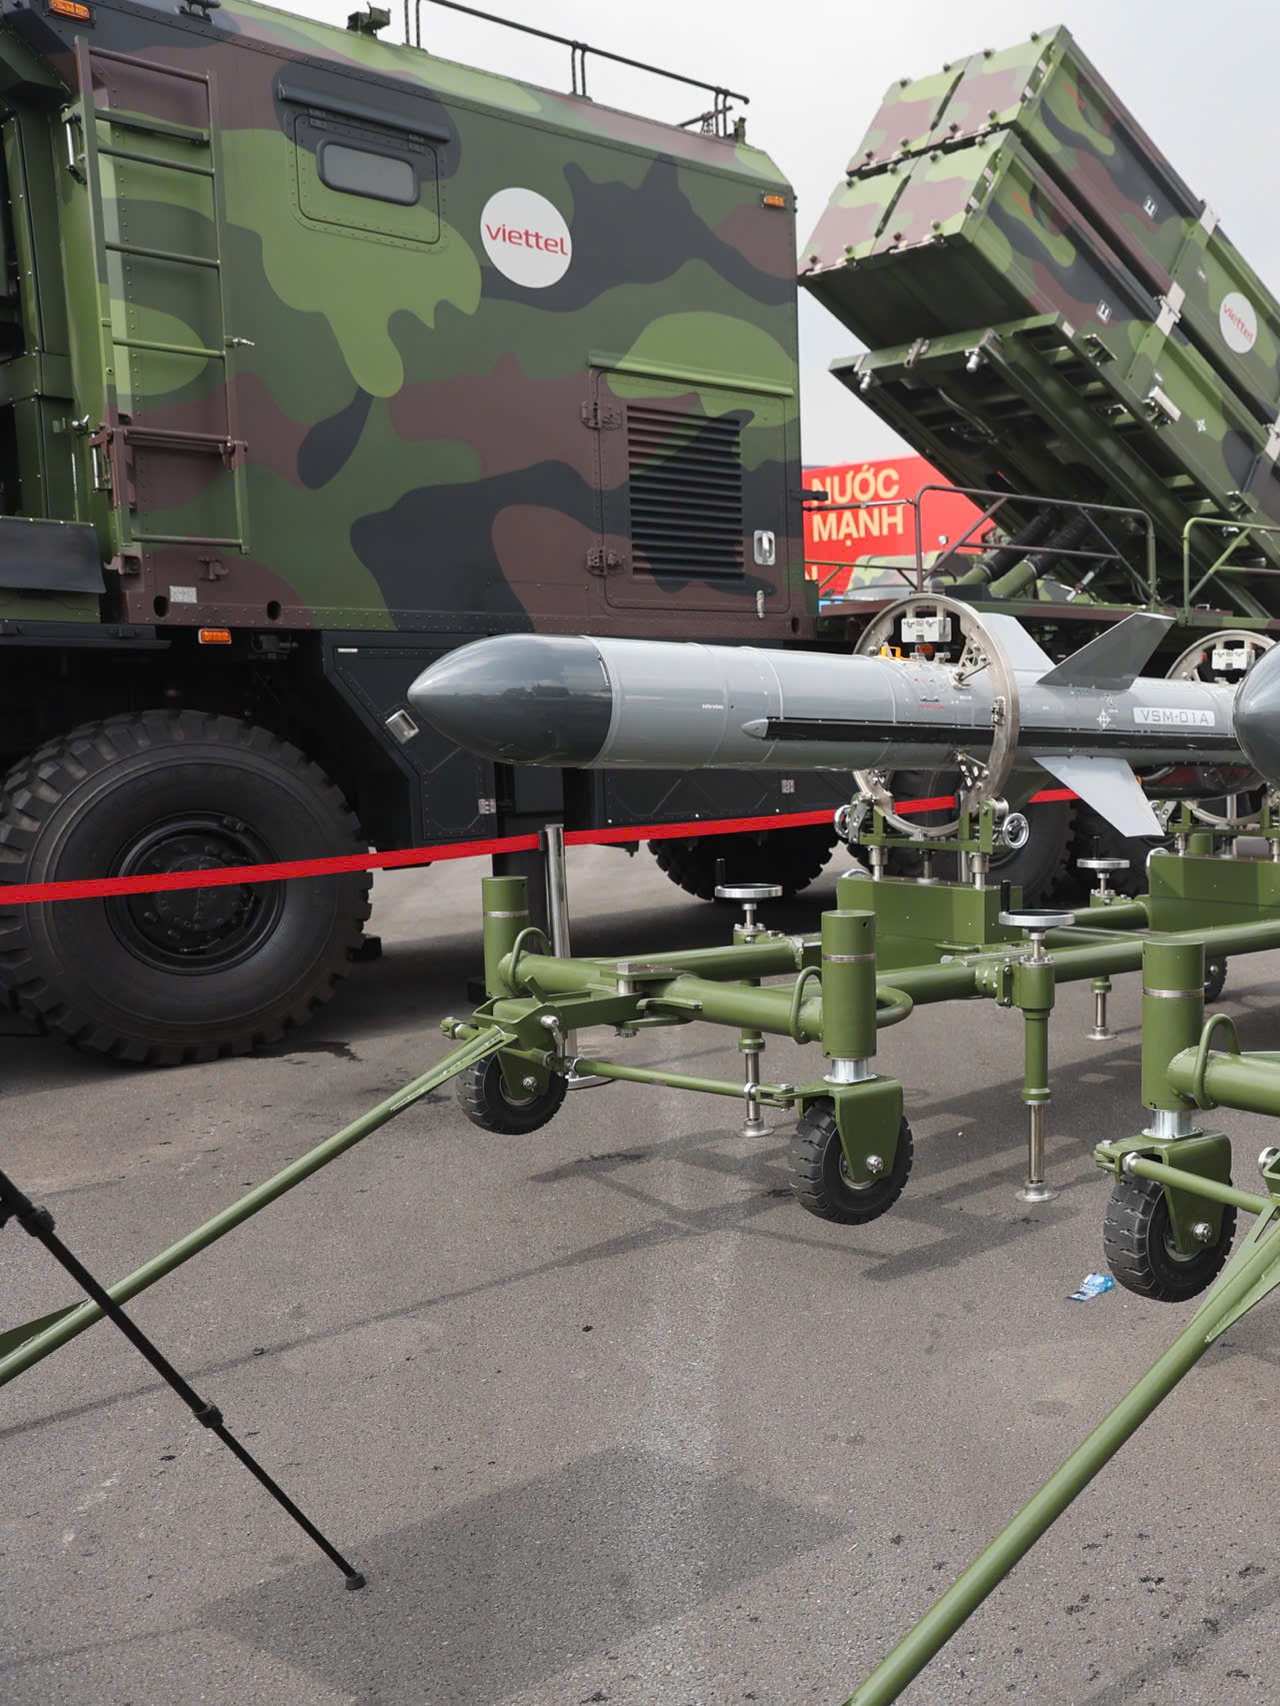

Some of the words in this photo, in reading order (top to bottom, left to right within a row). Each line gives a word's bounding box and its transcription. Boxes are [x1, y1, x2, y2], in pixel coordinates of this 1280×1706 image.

[485, 223, 568, 256] viettel
[811, 463, 900, 507] NƯỚC
[812, 505, 904, 547] MẠNH
